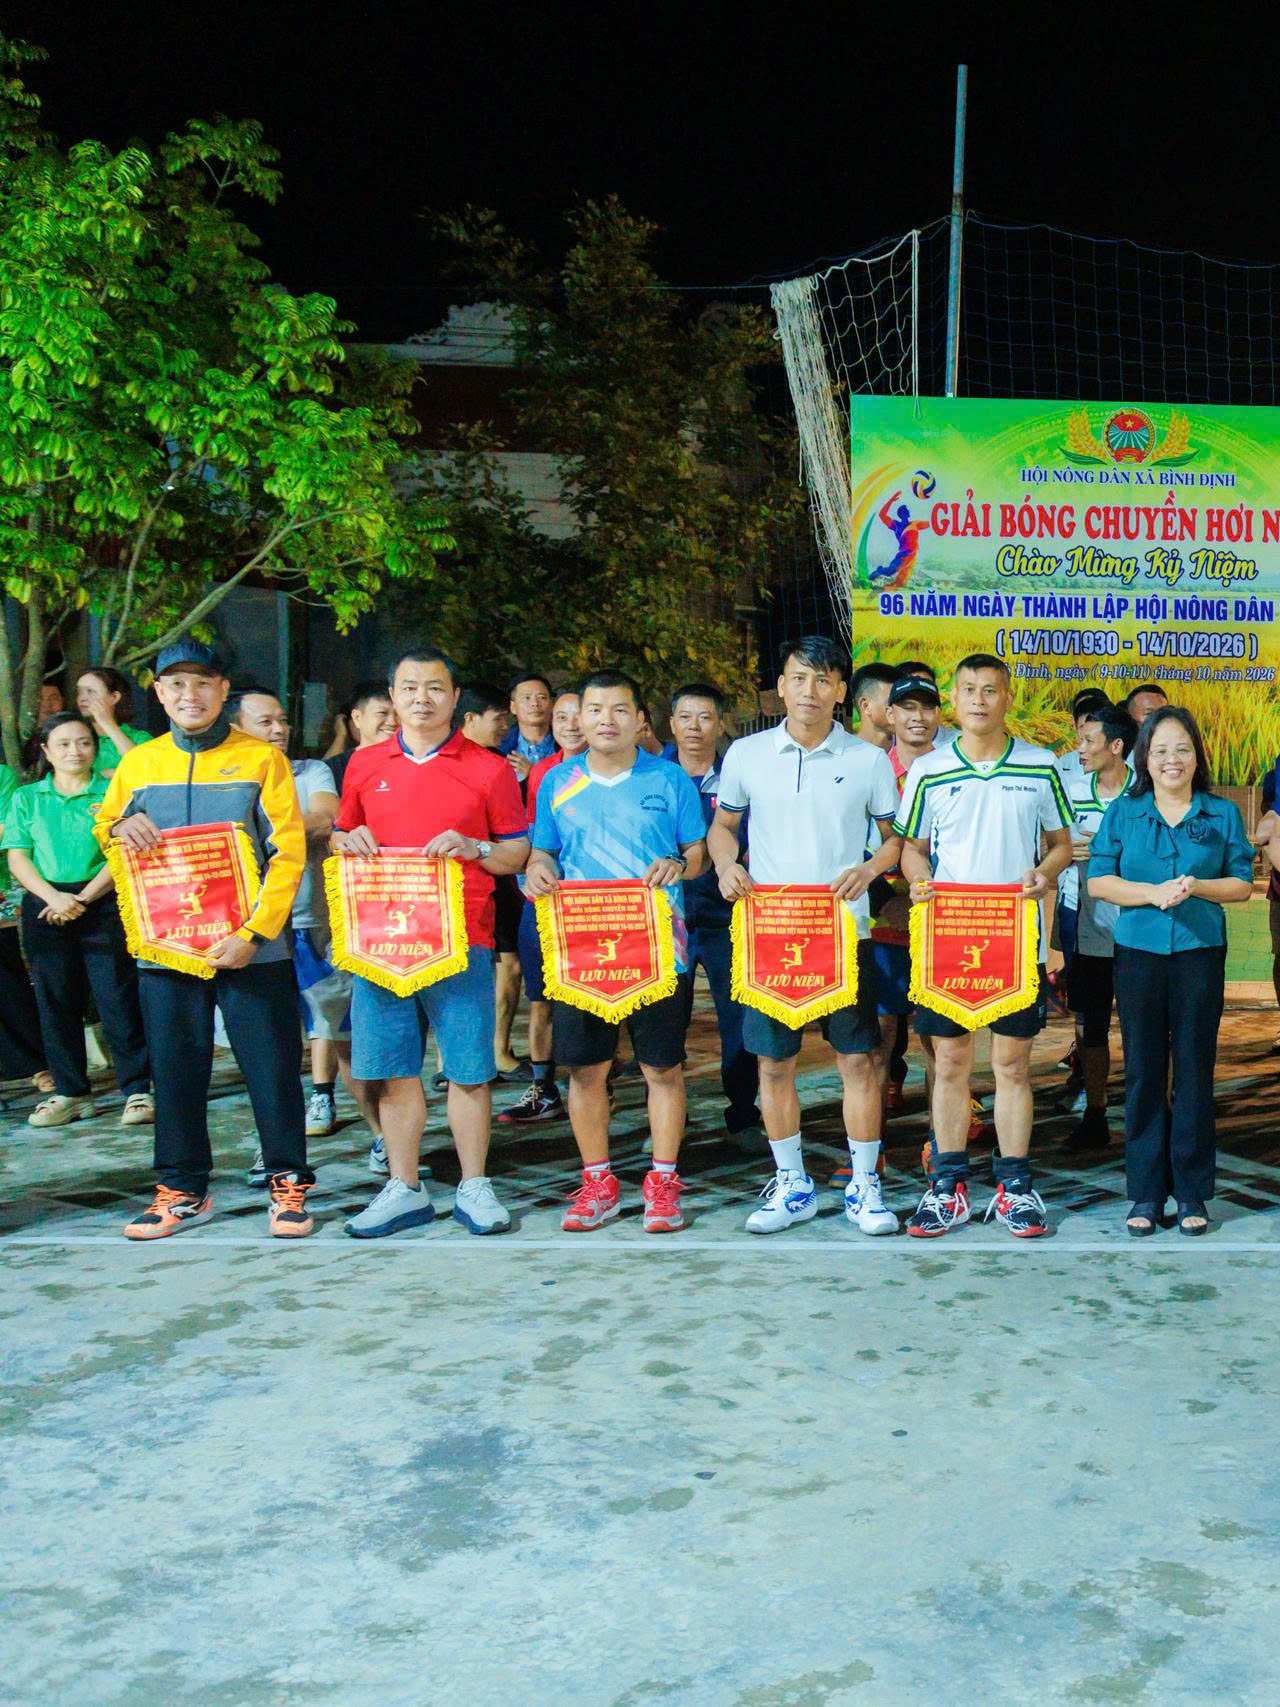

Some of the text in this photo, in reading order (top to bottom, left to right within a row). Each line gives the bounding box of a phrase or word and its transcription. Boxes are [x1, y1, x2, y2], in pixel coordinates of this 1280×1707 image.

[1021, 466, 1235, 489] HỘI NÔNG DÂN XÃ BÌNH ĐỊNH
[931, 488, 991, 537] GIẢI
[1000, 494, 1076, 538] BÓNG
[1084, 490, 1198, 542] CHUYỀN
[1205, 503, 1254, 543] HƠI
[996, 544, 1259, 588] Chào Mừng Kỷ Niệm
[880, 593, 904, 616] 96
[911, 589, 956, 616] NĂM
[964, 591, 1016, 618] NGÀY
[1022, 592, 1086, 618] THÀNH
[1093, 593, 1129, 624] LẬP
[1135, 594, 1167, 625] HỘI
[1174, 595, 1228, 621] NÔNG
[1235, 596, 1273, 622] DÂN
[1010, 629, 1120, 656] 14/10/1930
[1137, 632, 1245, 658] 14/10/2026
[1016, 662, 1051, 679] Định,
[1055, 666, 1088, 681] ngày
[1154, 665, 1192, 682] tháng
[1197, 666, 1209, 680] 10
[1213, 666, 1242, 681] năm
[1245, 667, 1275, 681] 2026
[580, 966, 641, 984] LƯU NIỆM
[766, 972, 824, 990] LƯU NIỆM
[943, 976, 1004, 992] LƯU NIỆM
